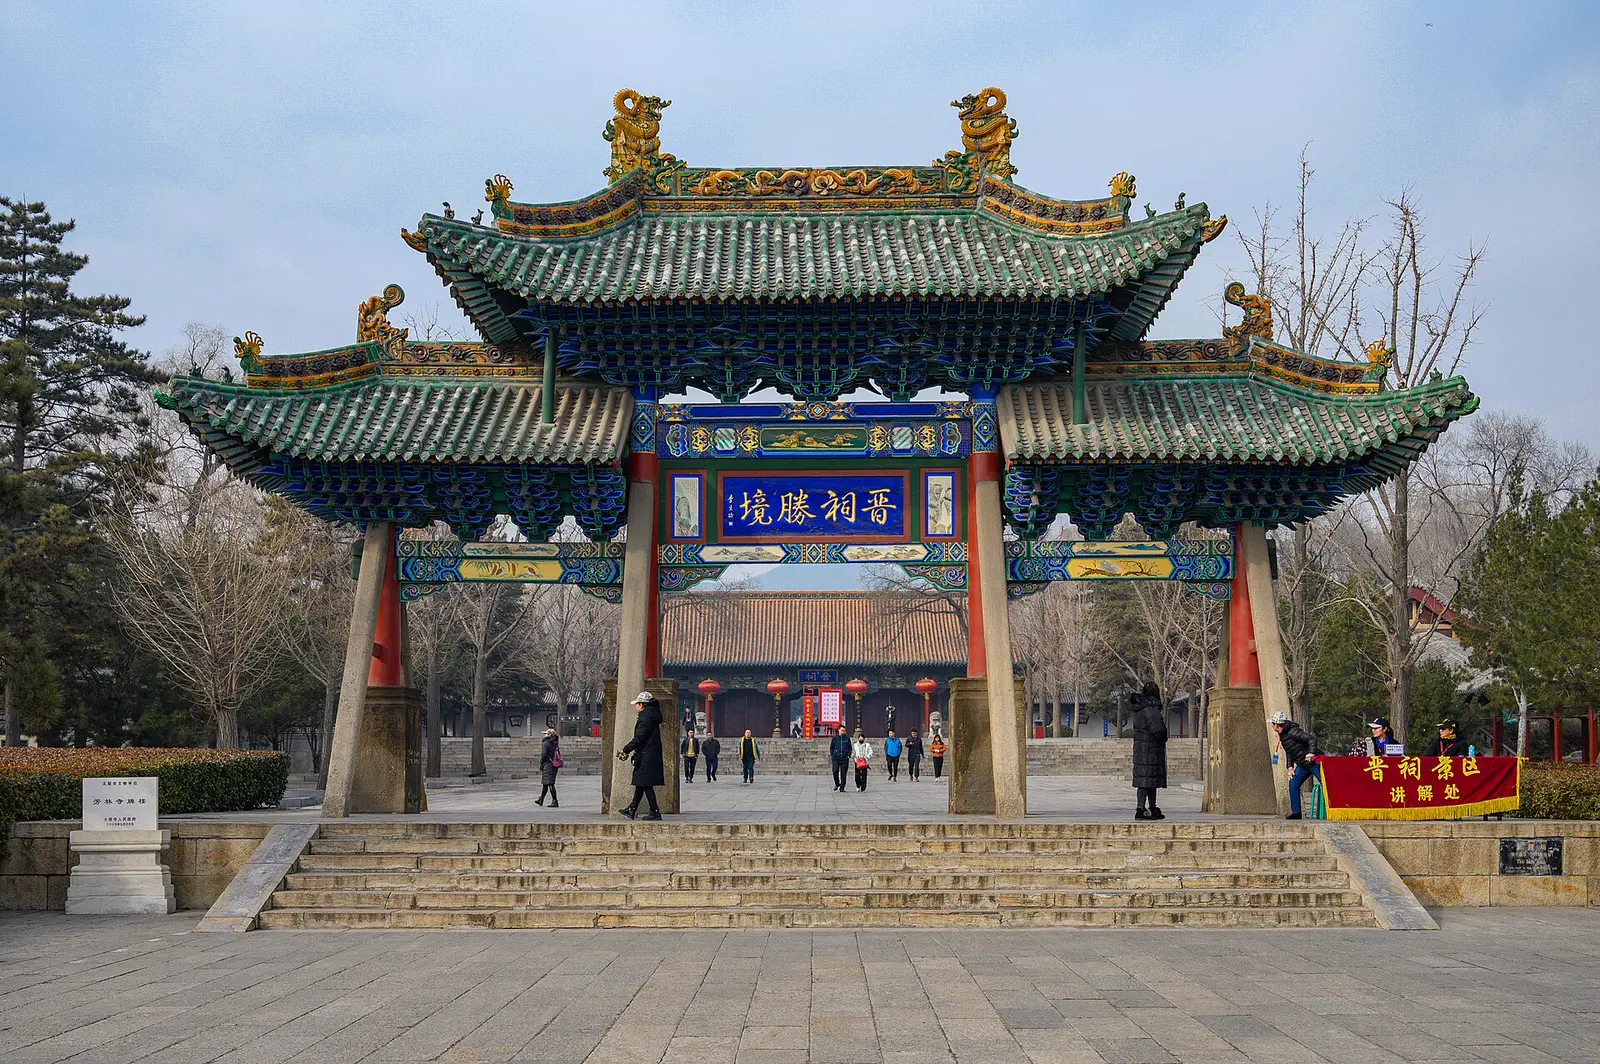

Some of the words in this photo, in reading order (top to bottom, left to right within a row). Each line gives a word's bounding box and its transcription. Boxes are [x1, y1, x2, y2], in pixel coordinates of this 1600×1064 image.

[1363, 756, 1480, 782] 晋祠景区
[1390, 784, 1460, 803] 讲解处
